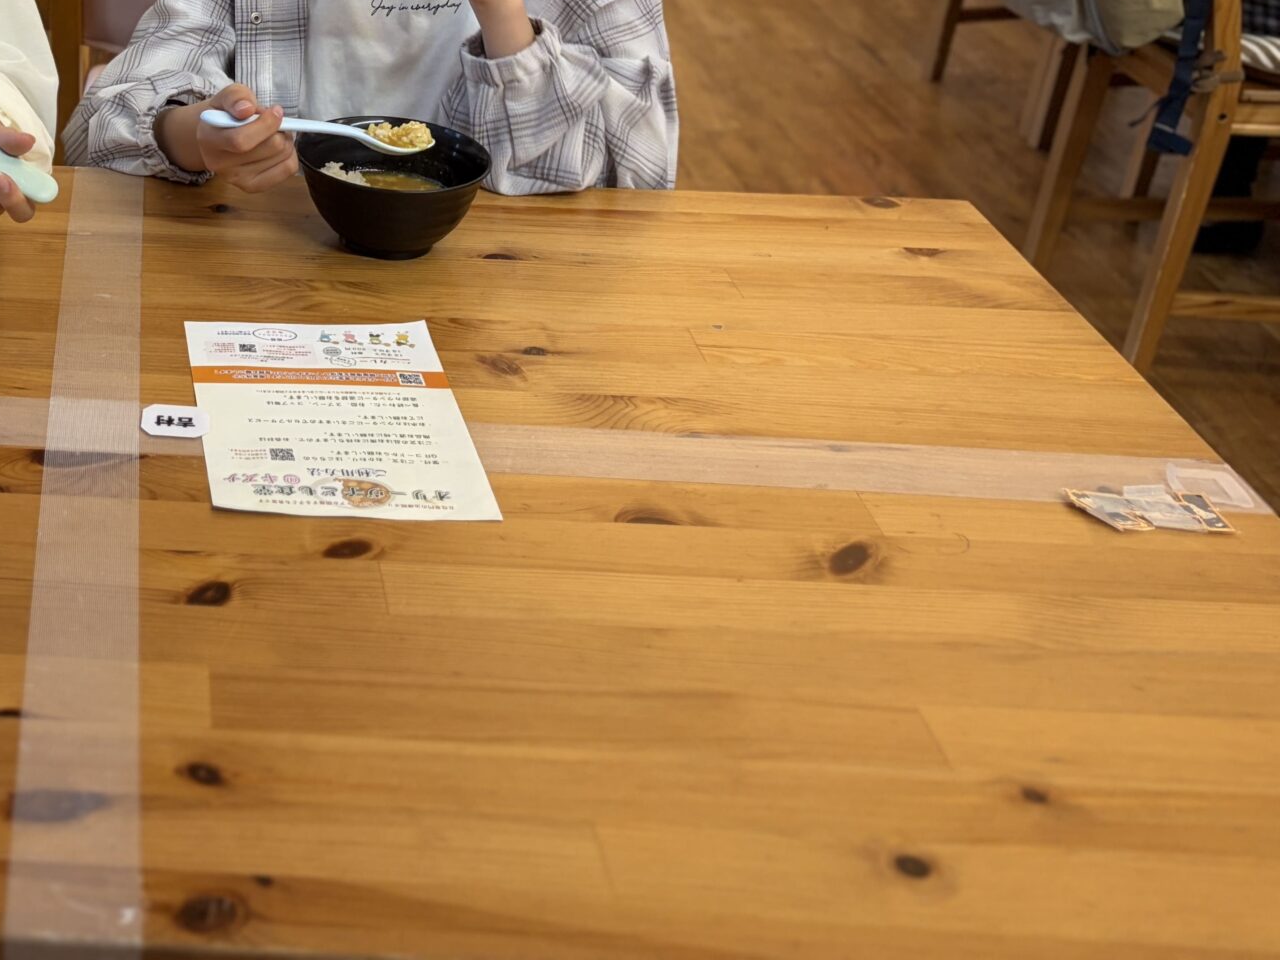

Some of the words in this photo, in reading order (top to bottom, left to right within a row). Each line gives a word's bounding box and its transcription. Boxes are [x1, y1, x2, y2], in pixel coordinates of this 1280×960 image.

[154, 415, 196, 428] 吉村
[306, 468, 387, 478] ご利用方法
